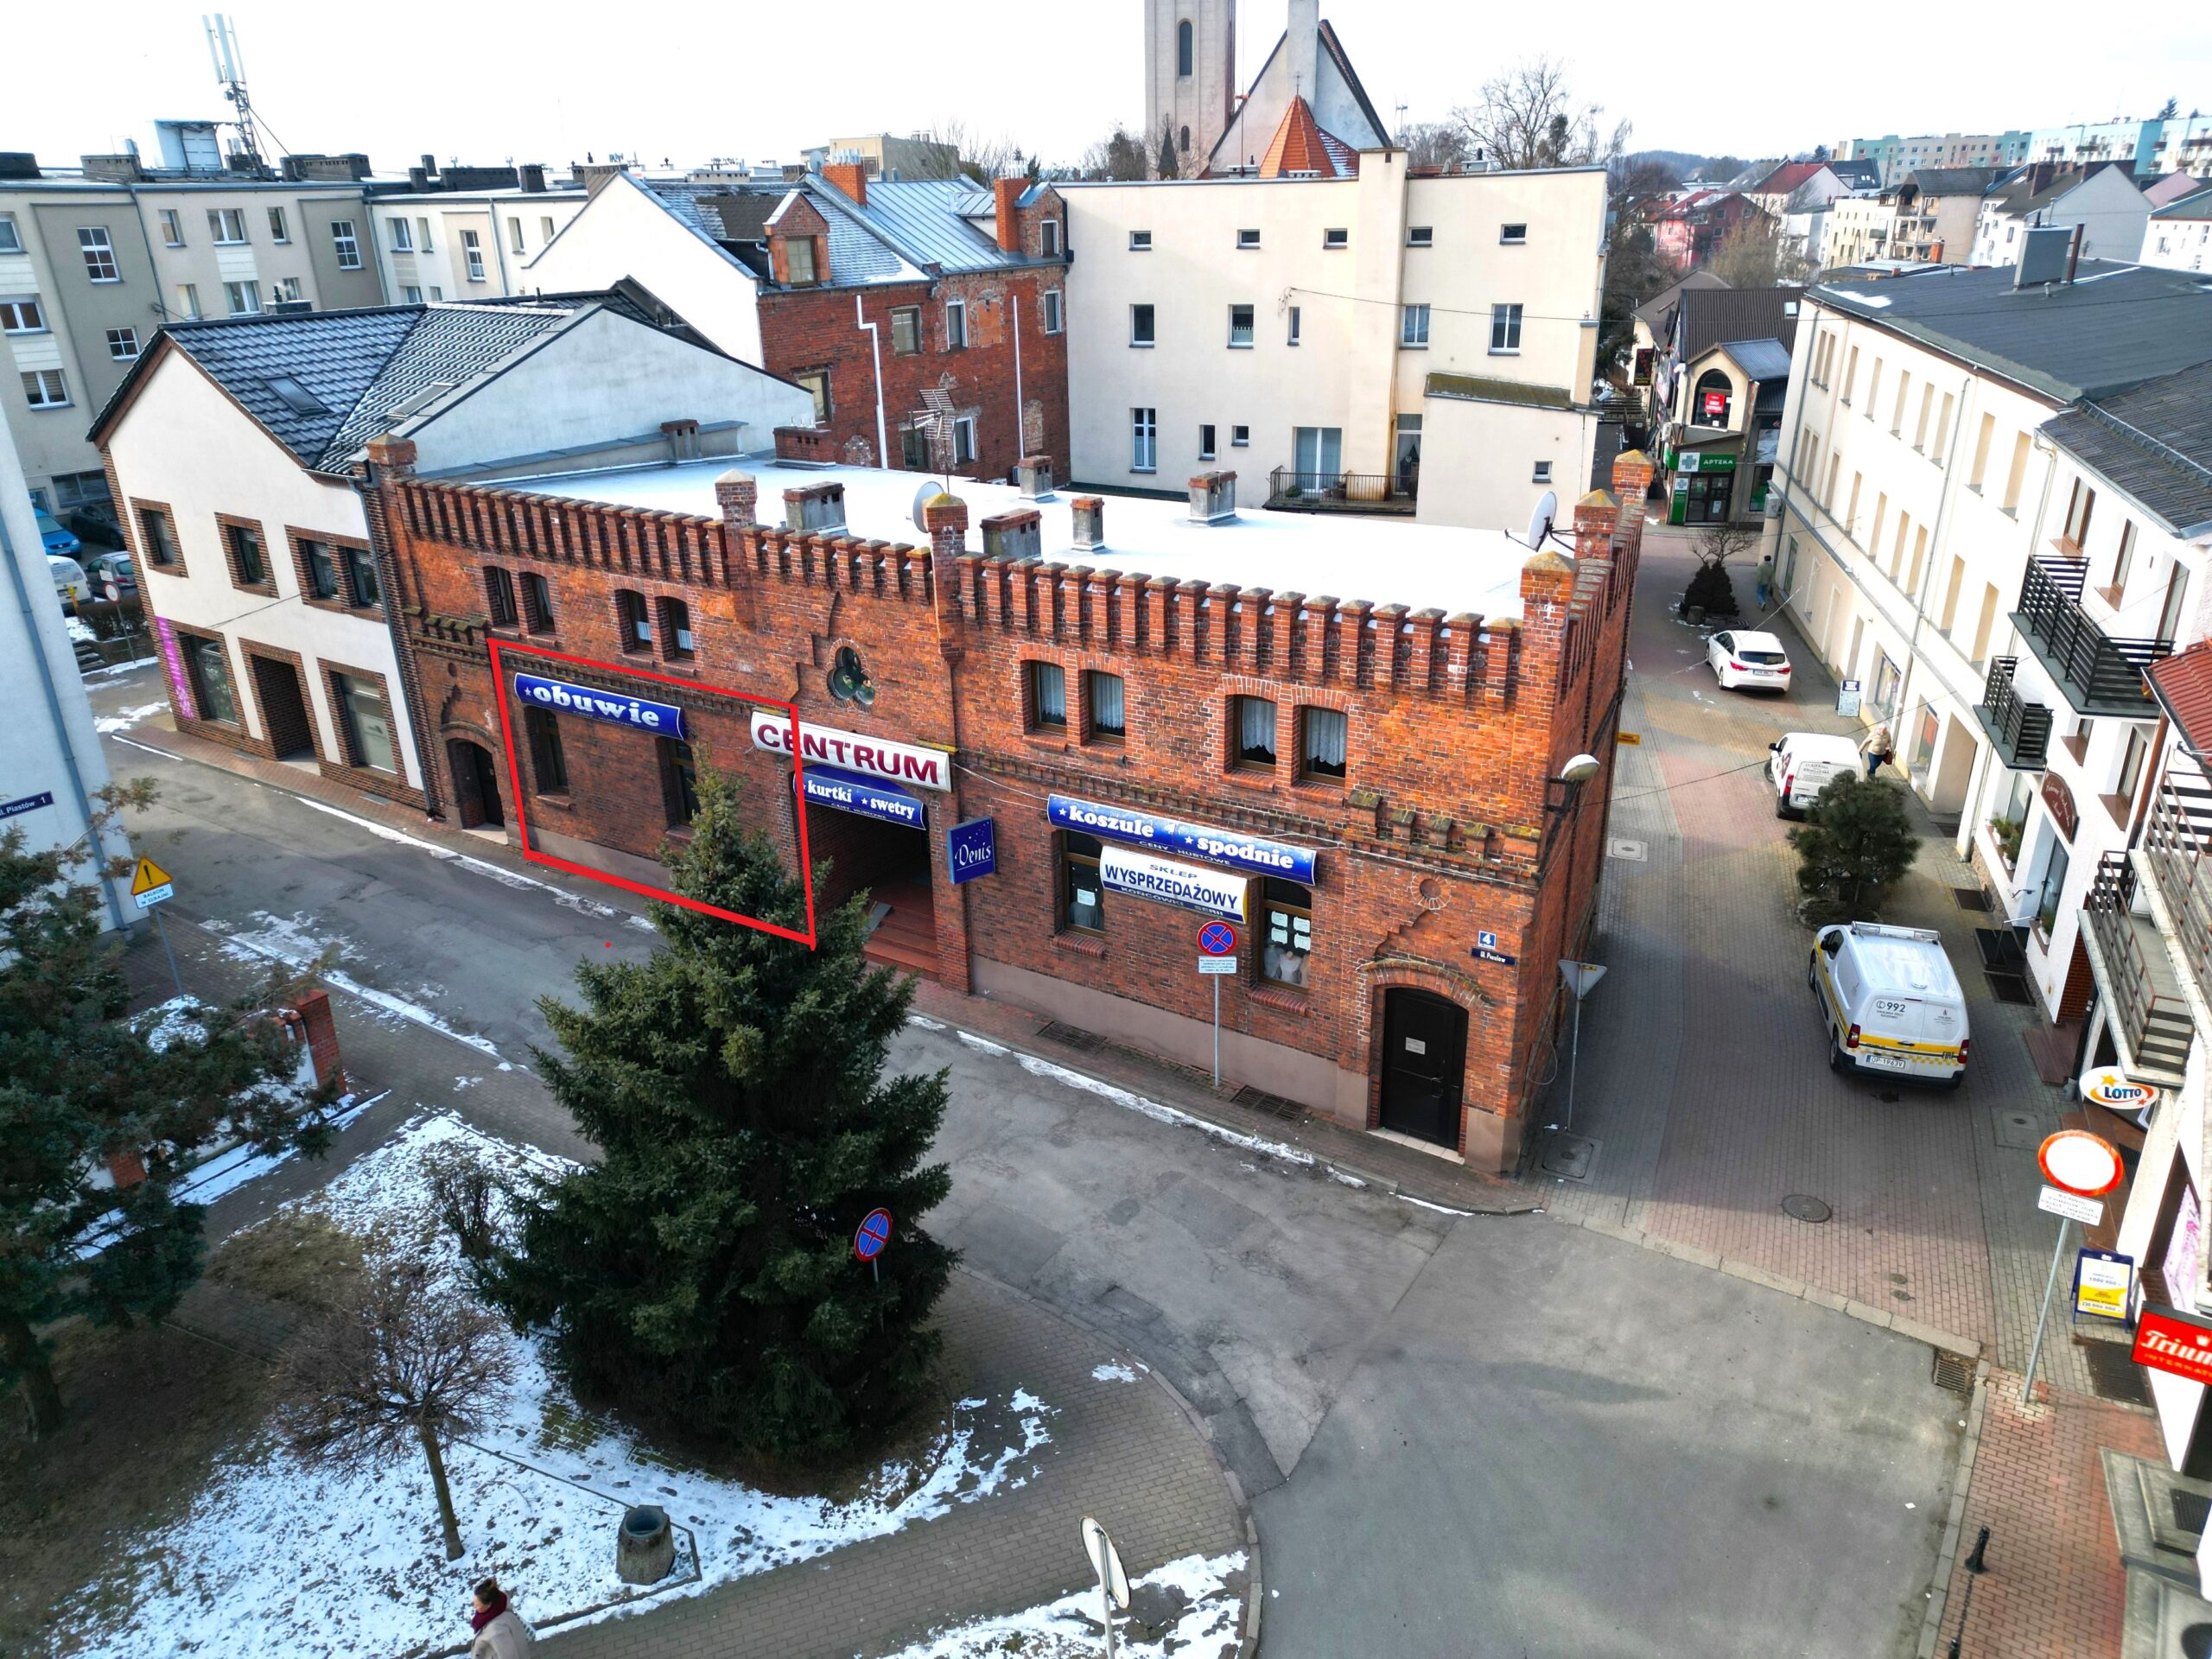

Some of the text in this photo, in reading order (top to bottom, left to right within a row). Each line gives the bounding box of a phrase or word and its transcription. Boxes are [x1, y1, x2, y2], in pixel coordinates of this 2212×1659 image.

[533, 685, 659, 727] obuwie
[758, 724, 939, 785] CENTRUM
[6, 801, 35, 813] Piastów
[807, 779, 915, 820] kurtki swetry
[1069, 805, 1294, 869] koszule spodnie
[955, 842, 991, 866] Denis
[1139, 841, 1230, 865] CENY HURTOWE
[1149, 864, 1198, 879] SKLEP
[1105, 864, 1237, 909] WYSPRZEDAŻOWY
[1482, 934, 1491, 944] 4
[1886, 1002, 1906, 1013] 992
[2104, 1086, 2142, 1099] LOTTO
